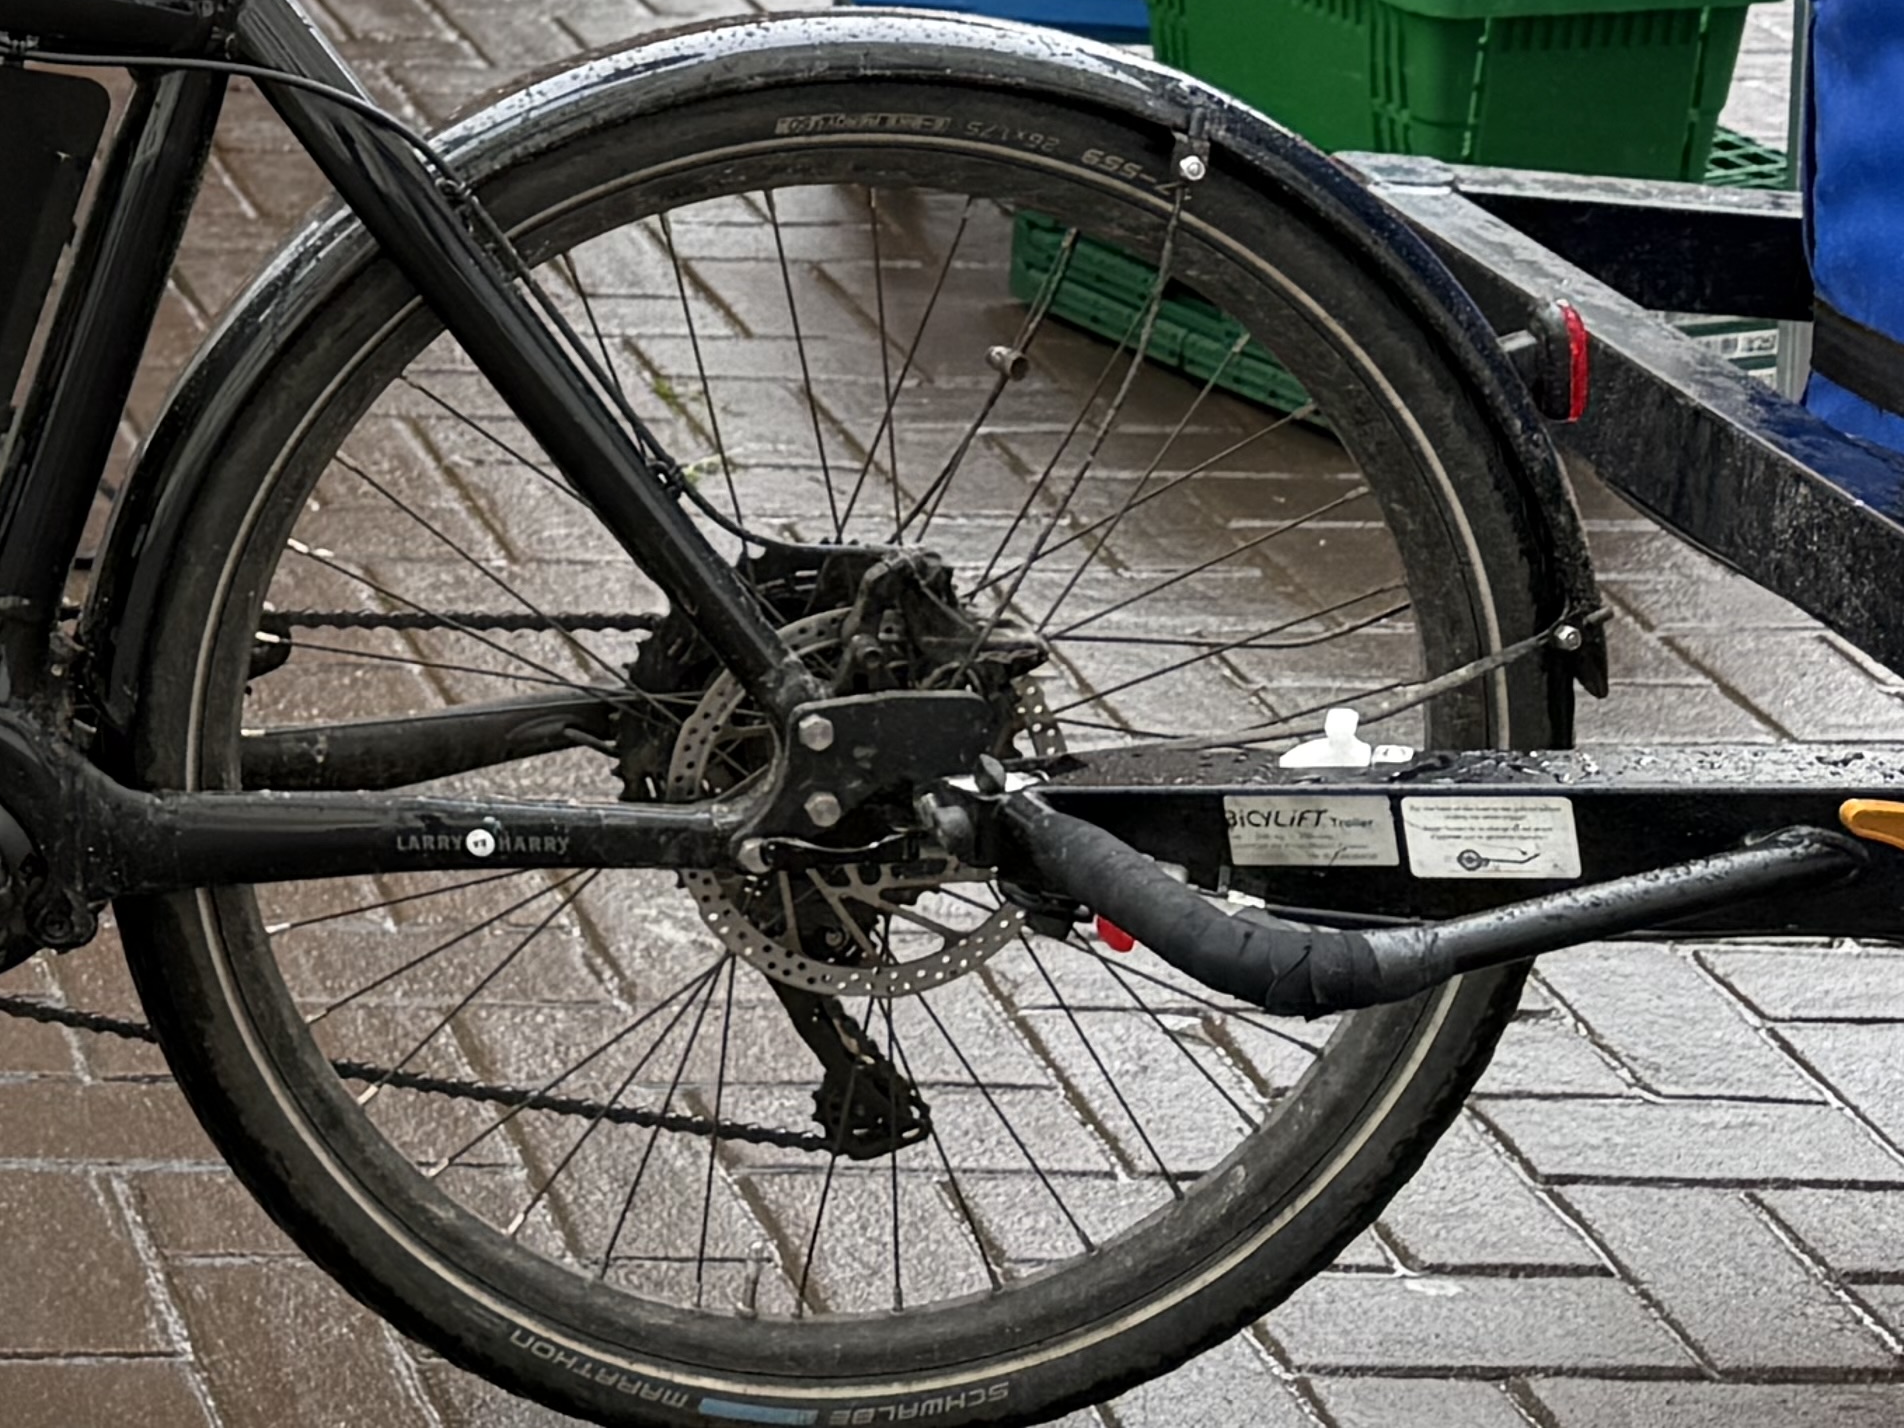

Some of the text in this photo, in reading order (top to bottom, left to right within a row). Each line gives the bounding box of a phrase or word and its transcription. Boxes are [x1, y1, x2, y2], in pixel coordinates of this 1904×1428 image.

[396, 835, 462, 852] LARRY
[496, 835, 571, 855] HARRY
[509, 1327, 1010, 1426] SCHWALBE MARATHON
